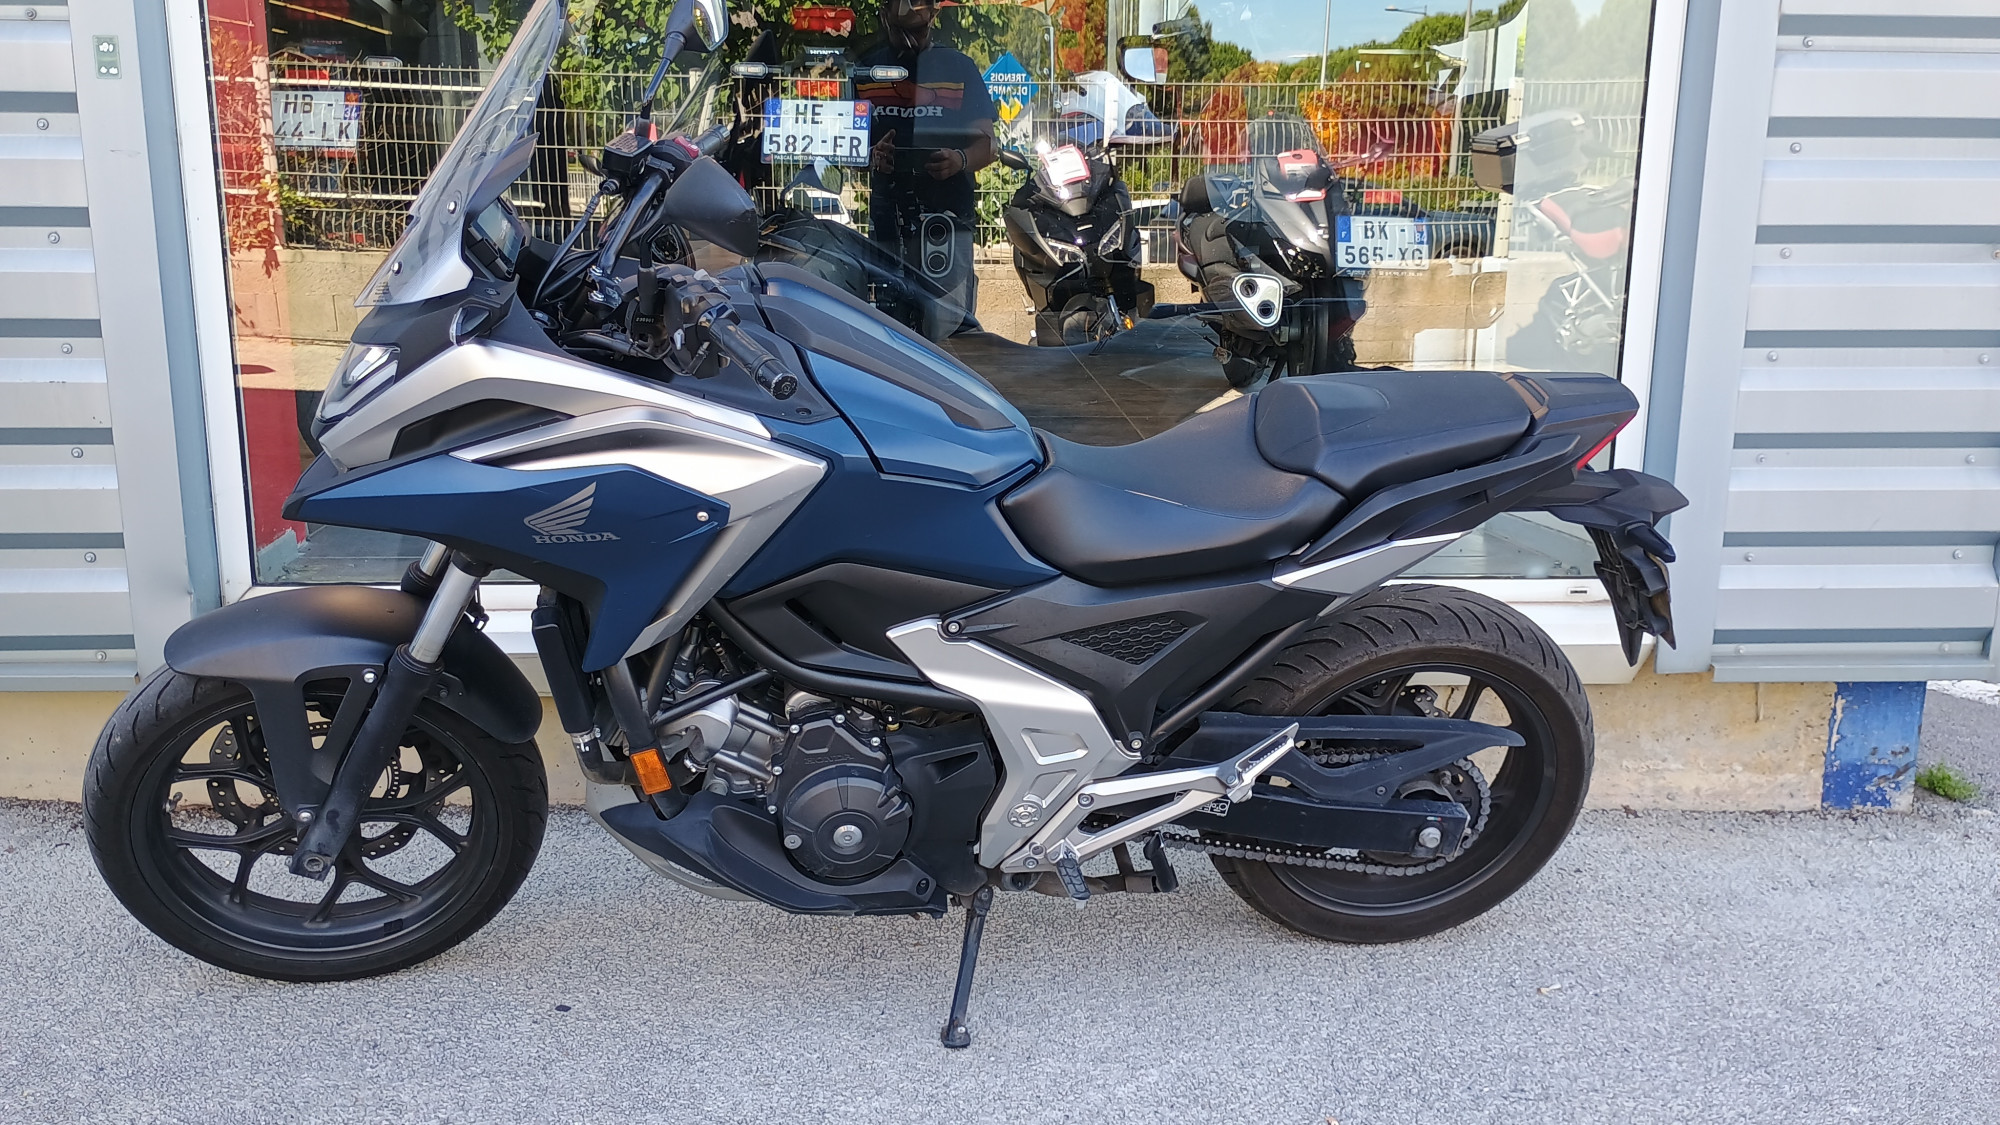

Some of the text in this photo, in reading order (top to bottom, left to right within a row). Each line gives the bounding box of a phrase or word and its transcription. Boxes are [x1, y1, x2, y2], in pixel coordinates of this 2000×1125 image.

[284, 93, 313, 114] HB
[795, 103, 824, 125] HE
[854, 117, 868, 129] 34
[1364, 220, 1389, 240] BK
[531, 531, 622, 544] HONDA
[804, 753, 855, 765] HONDA
